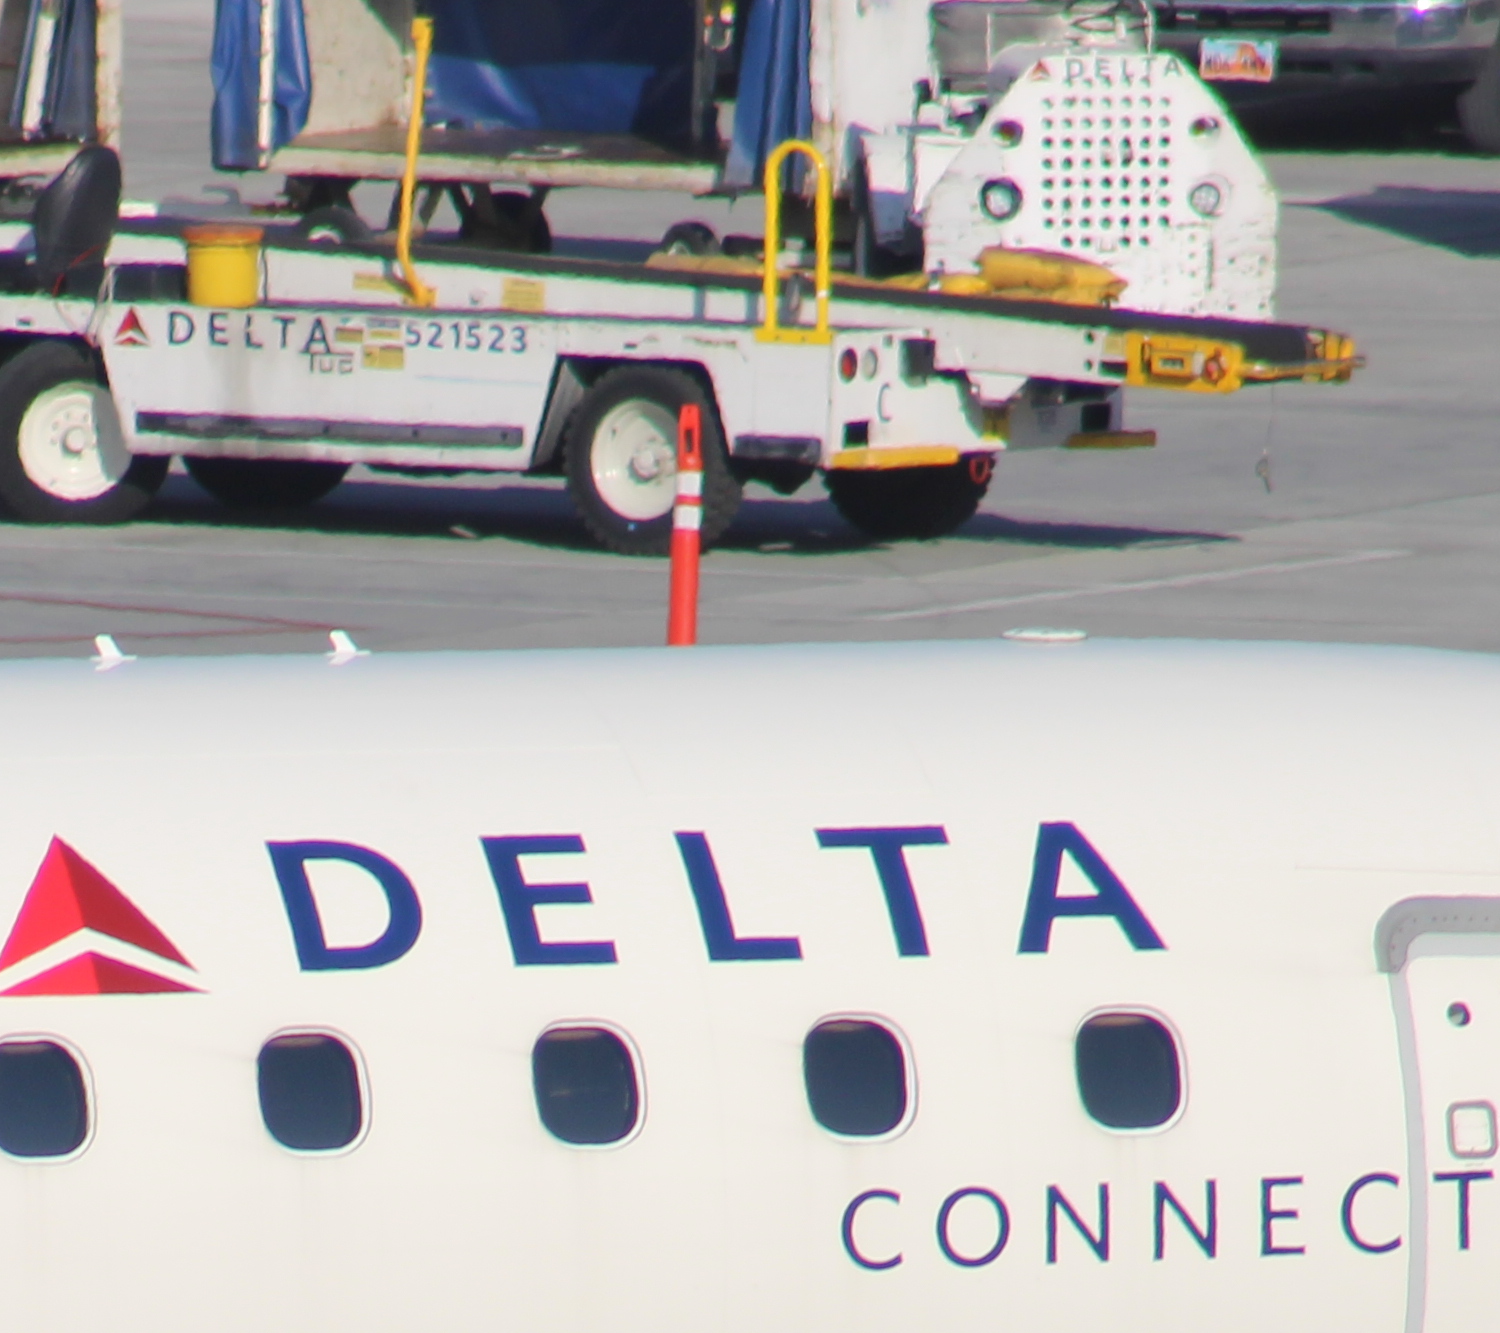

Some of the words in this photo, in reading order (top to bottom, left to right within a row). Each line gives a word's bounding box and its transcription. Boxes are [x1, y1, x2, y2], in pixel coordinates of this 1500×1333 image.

[1064, 55, 1183, 79] DELTA
[167, 310, 333, 356] DELTA
[405, 321, 528, 353] 521523
[266, 821, 1166, 972] DELTA
